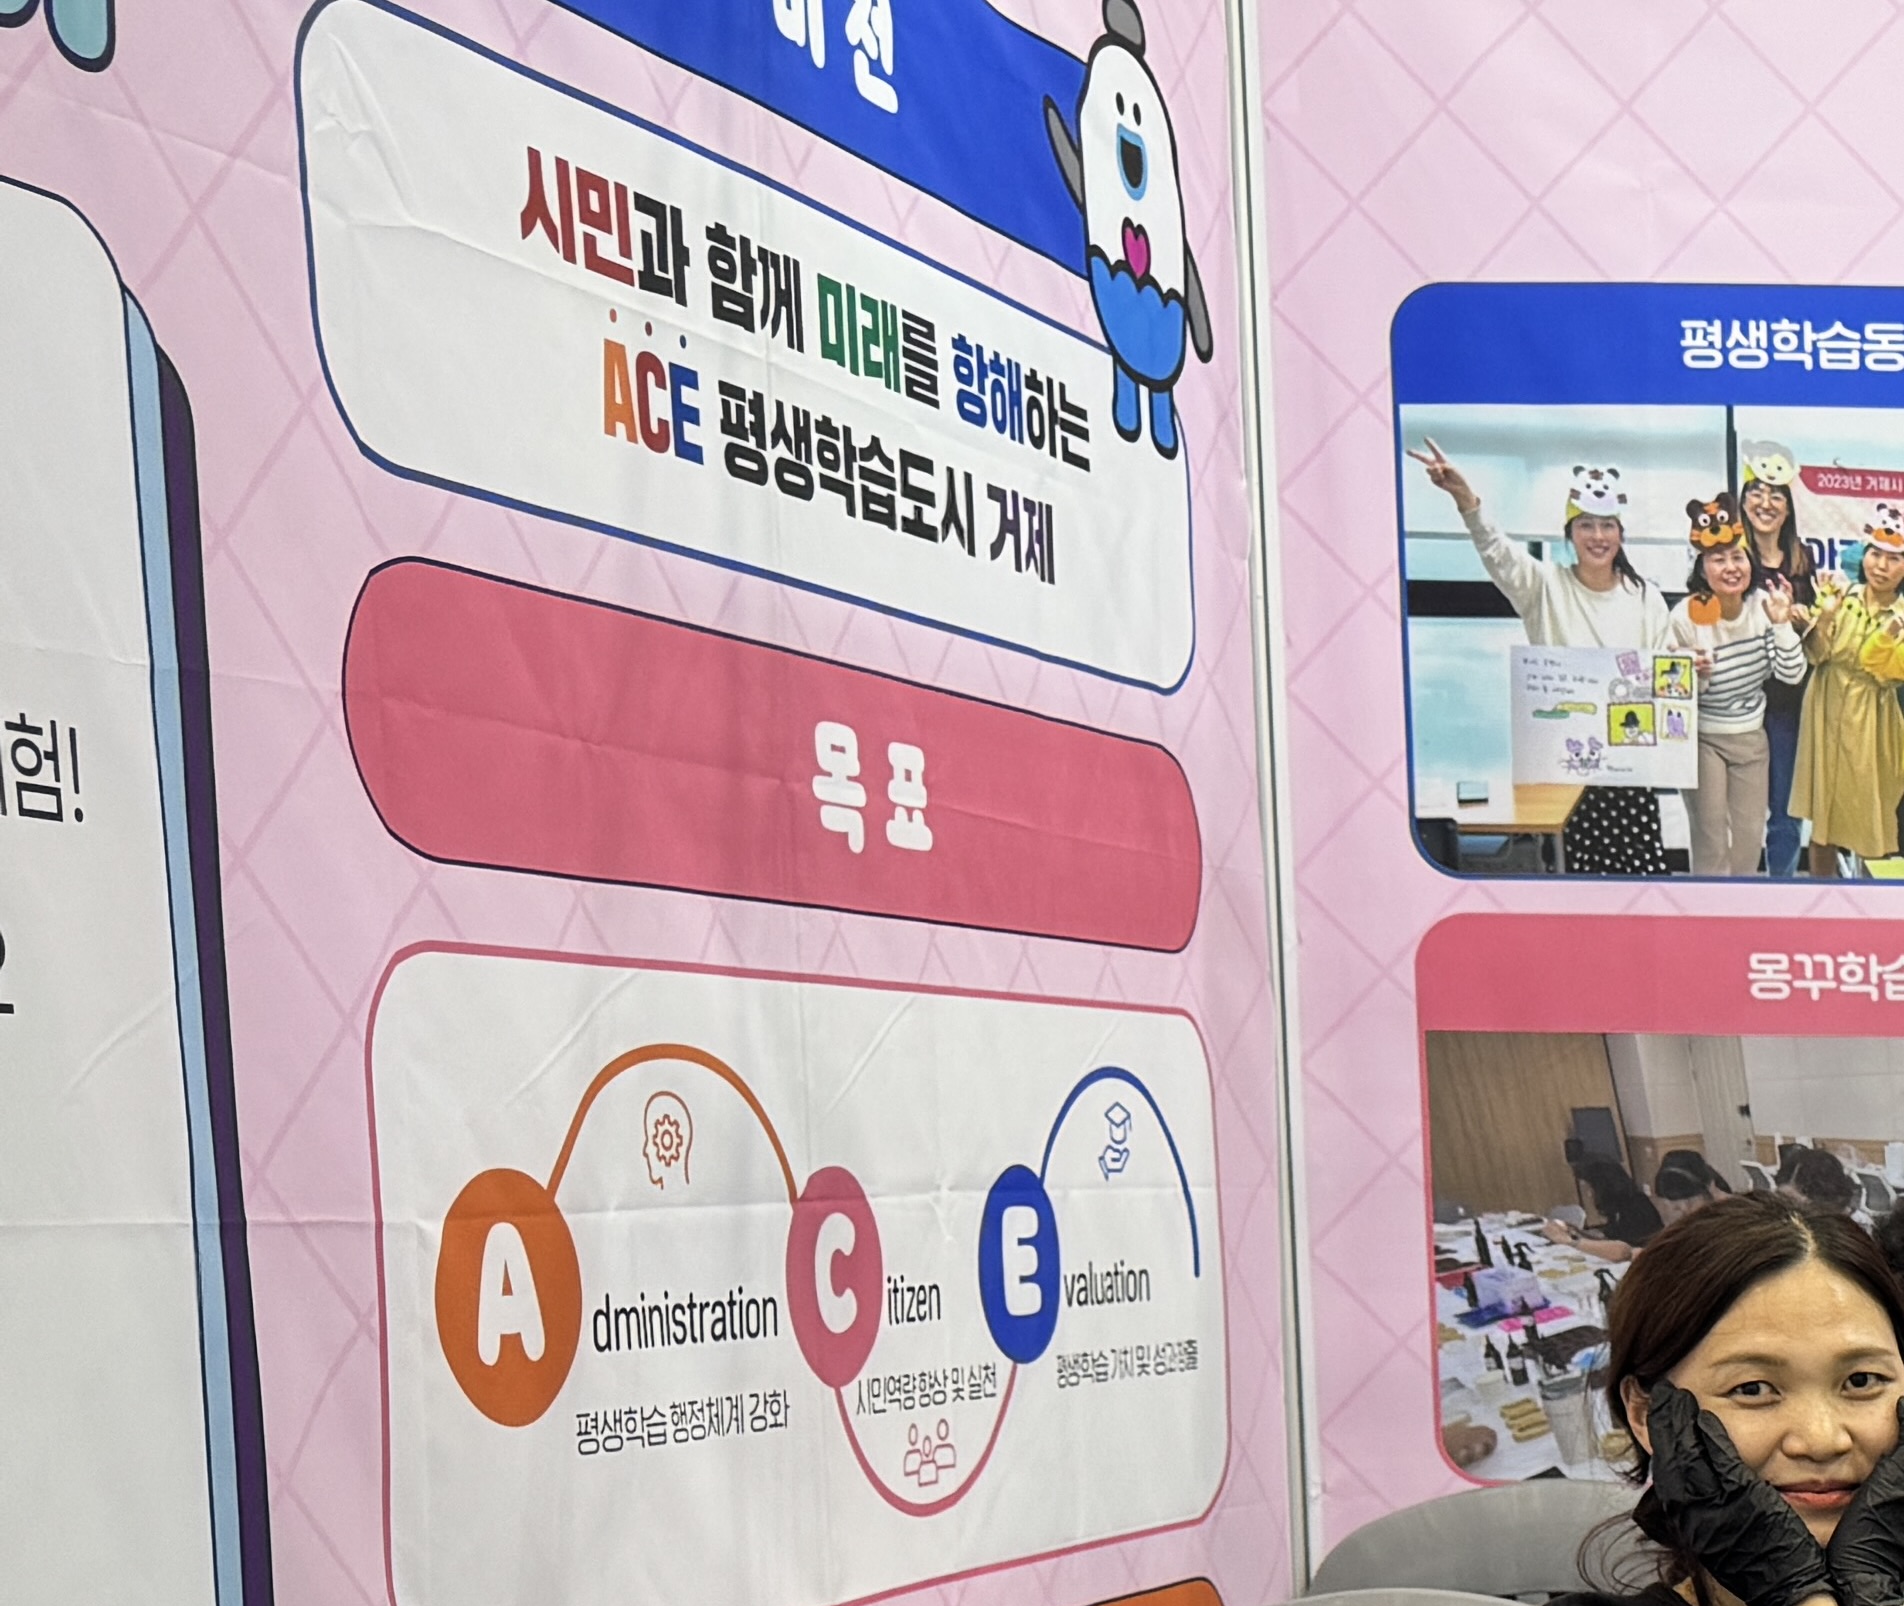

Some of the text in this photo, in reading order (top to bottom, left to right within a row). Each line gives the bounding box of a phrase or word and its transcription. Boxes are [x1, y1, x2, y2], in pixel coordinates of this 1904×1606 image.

[520, 145, 1092, 473] 시민과 함께 미래를 항해하는
[603, 338, 1057, 586] ACE 평생학습도시 거제
[0, 712, 84, 823] 험!
[812, 719, 934, 854] 목표
[576, 1388, 791, 1456] 평생학습 행정체계 강화
